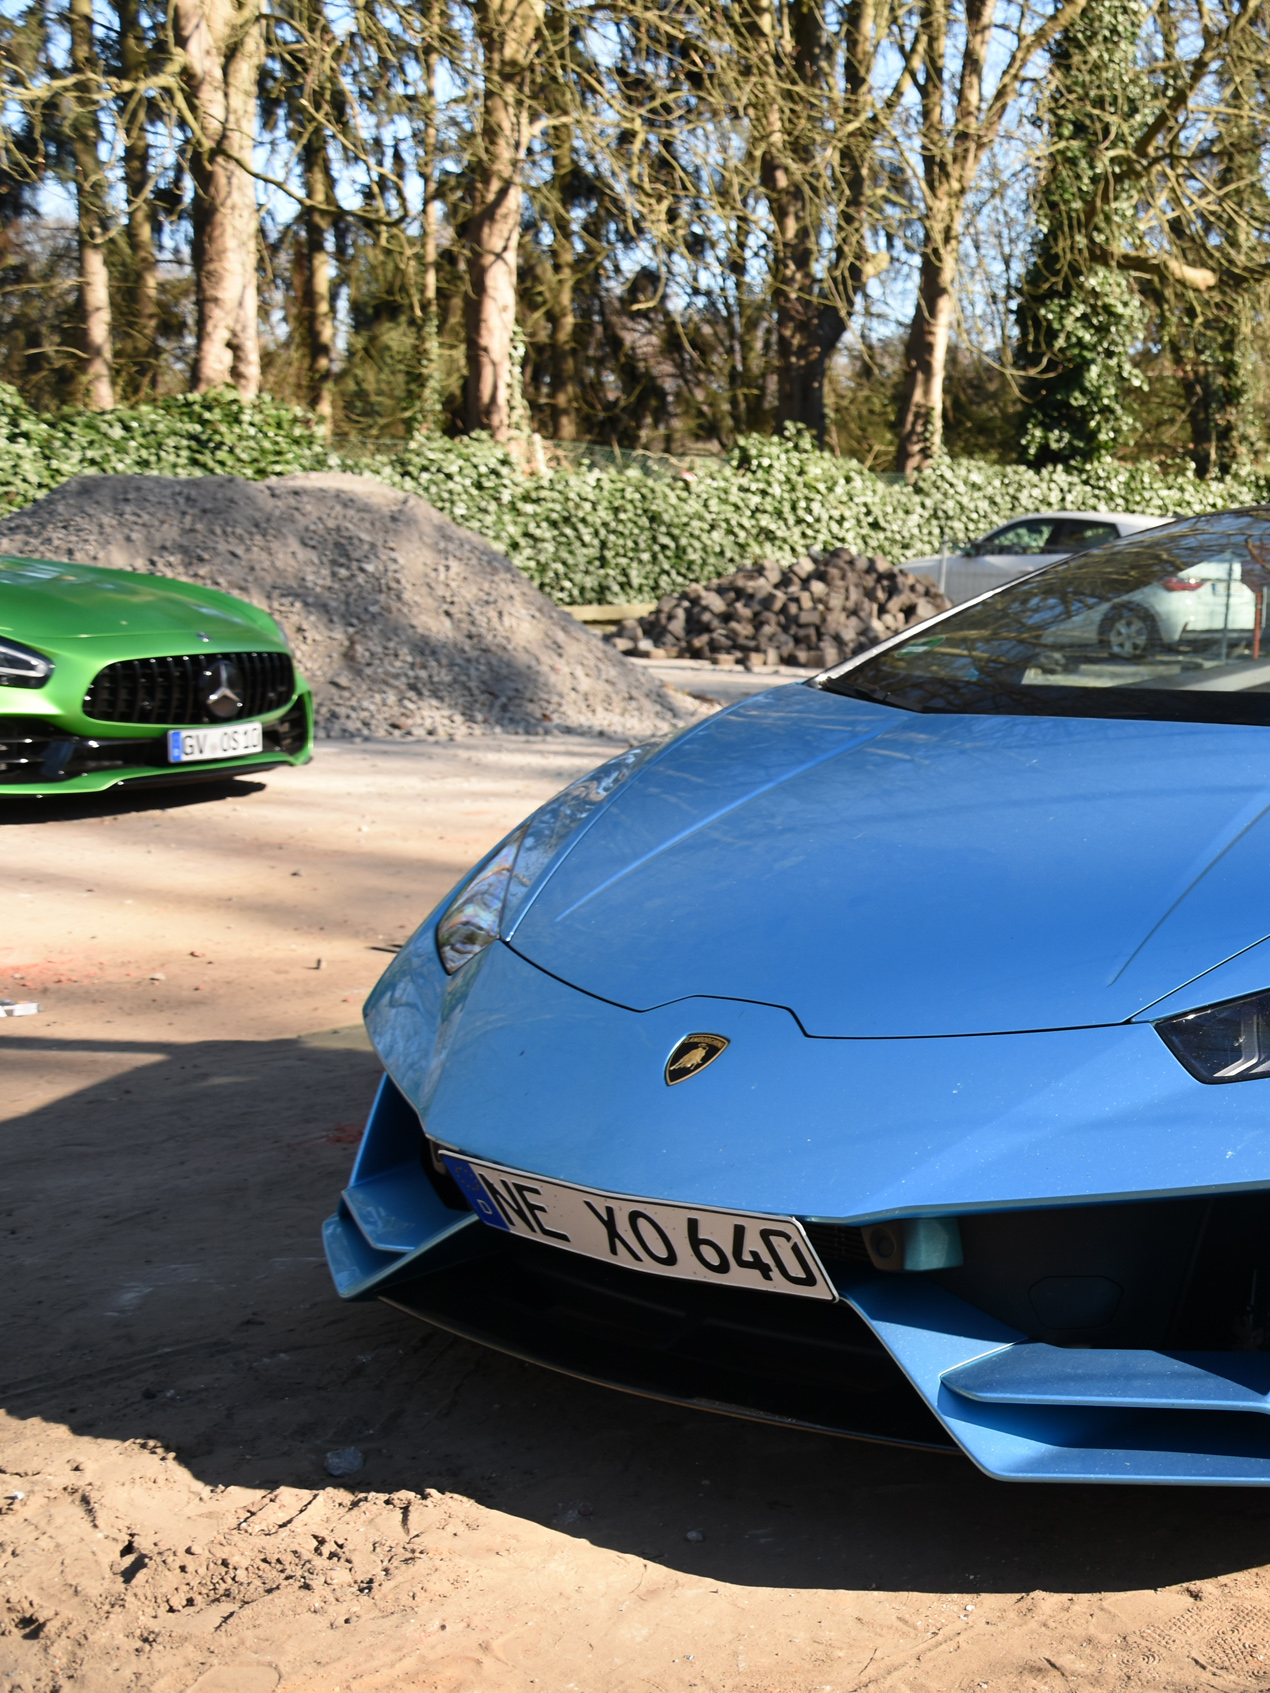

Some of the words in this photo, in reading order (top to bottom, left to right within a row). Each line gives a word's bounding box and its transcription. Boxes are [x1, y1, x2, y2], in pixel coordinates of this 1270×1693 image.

[183, 734, 207, 756] GV
[477, 1199, 492, 1215] D
[478, 1171, 571, 1243] NE
[583, 1199, 677, 1267] XO
[686, 1217, 818, 1288] 640
